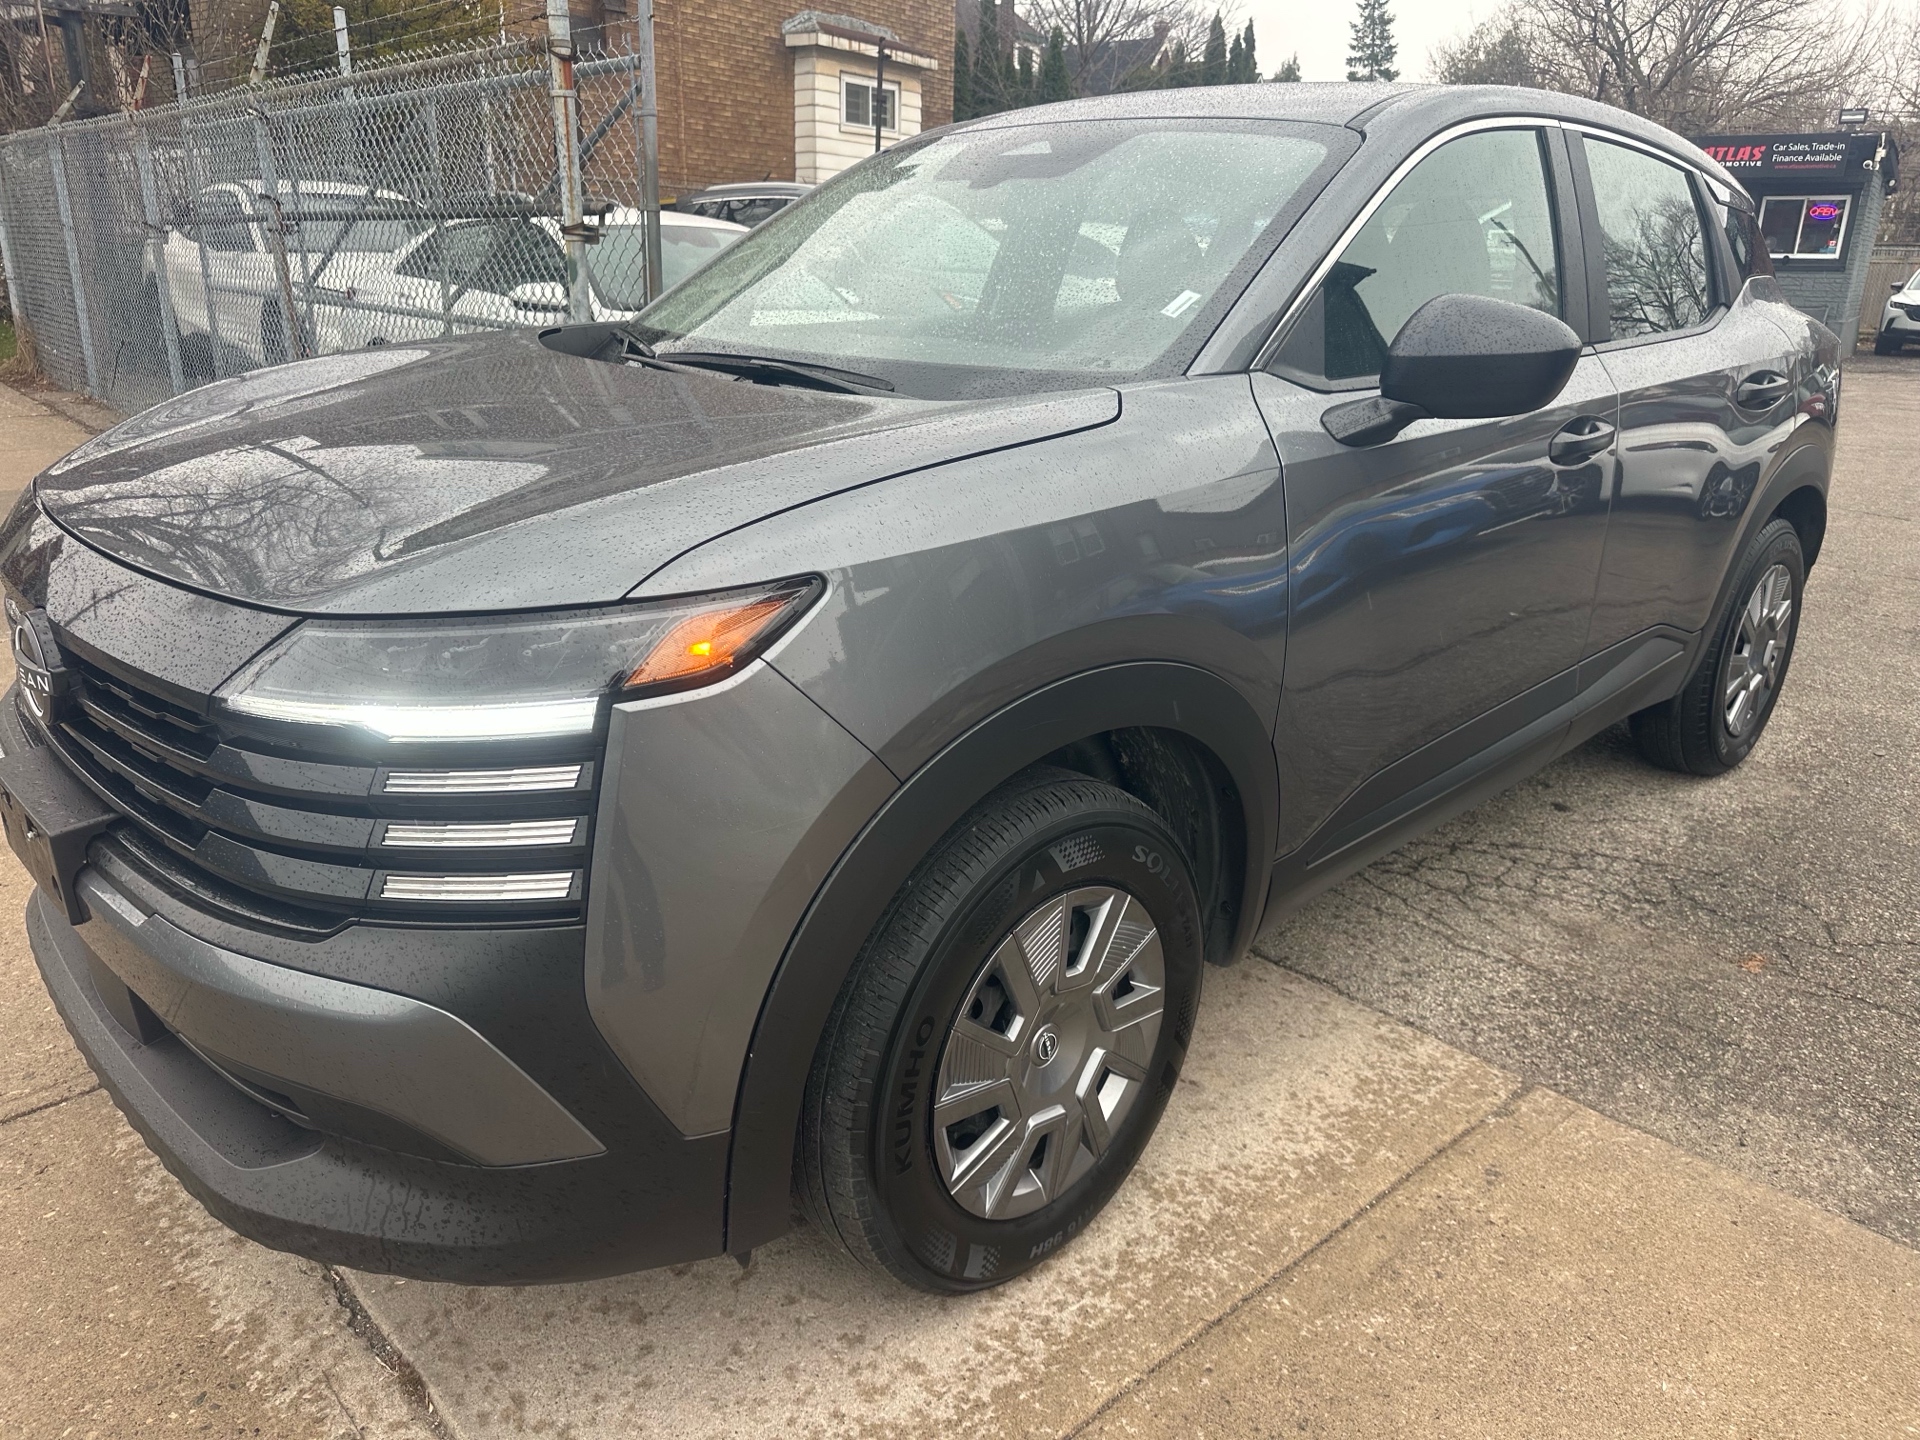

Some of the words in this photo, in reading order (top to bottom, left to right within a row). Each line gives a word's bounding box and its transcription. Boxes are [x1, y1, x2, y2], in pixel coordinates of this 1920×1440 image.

[1772, 143, 1787, 151] Car
[1788, 143, 1810, 151] Sales,
[1812, 142, 1846, 151] Trade-in
[1772, 154, 1803, 162] Finance
[1804, 153, 1842, 161] Available
[1810, 207, 1837, 216] OPEN
[895, 1015, 935, 1176] KUMHO
